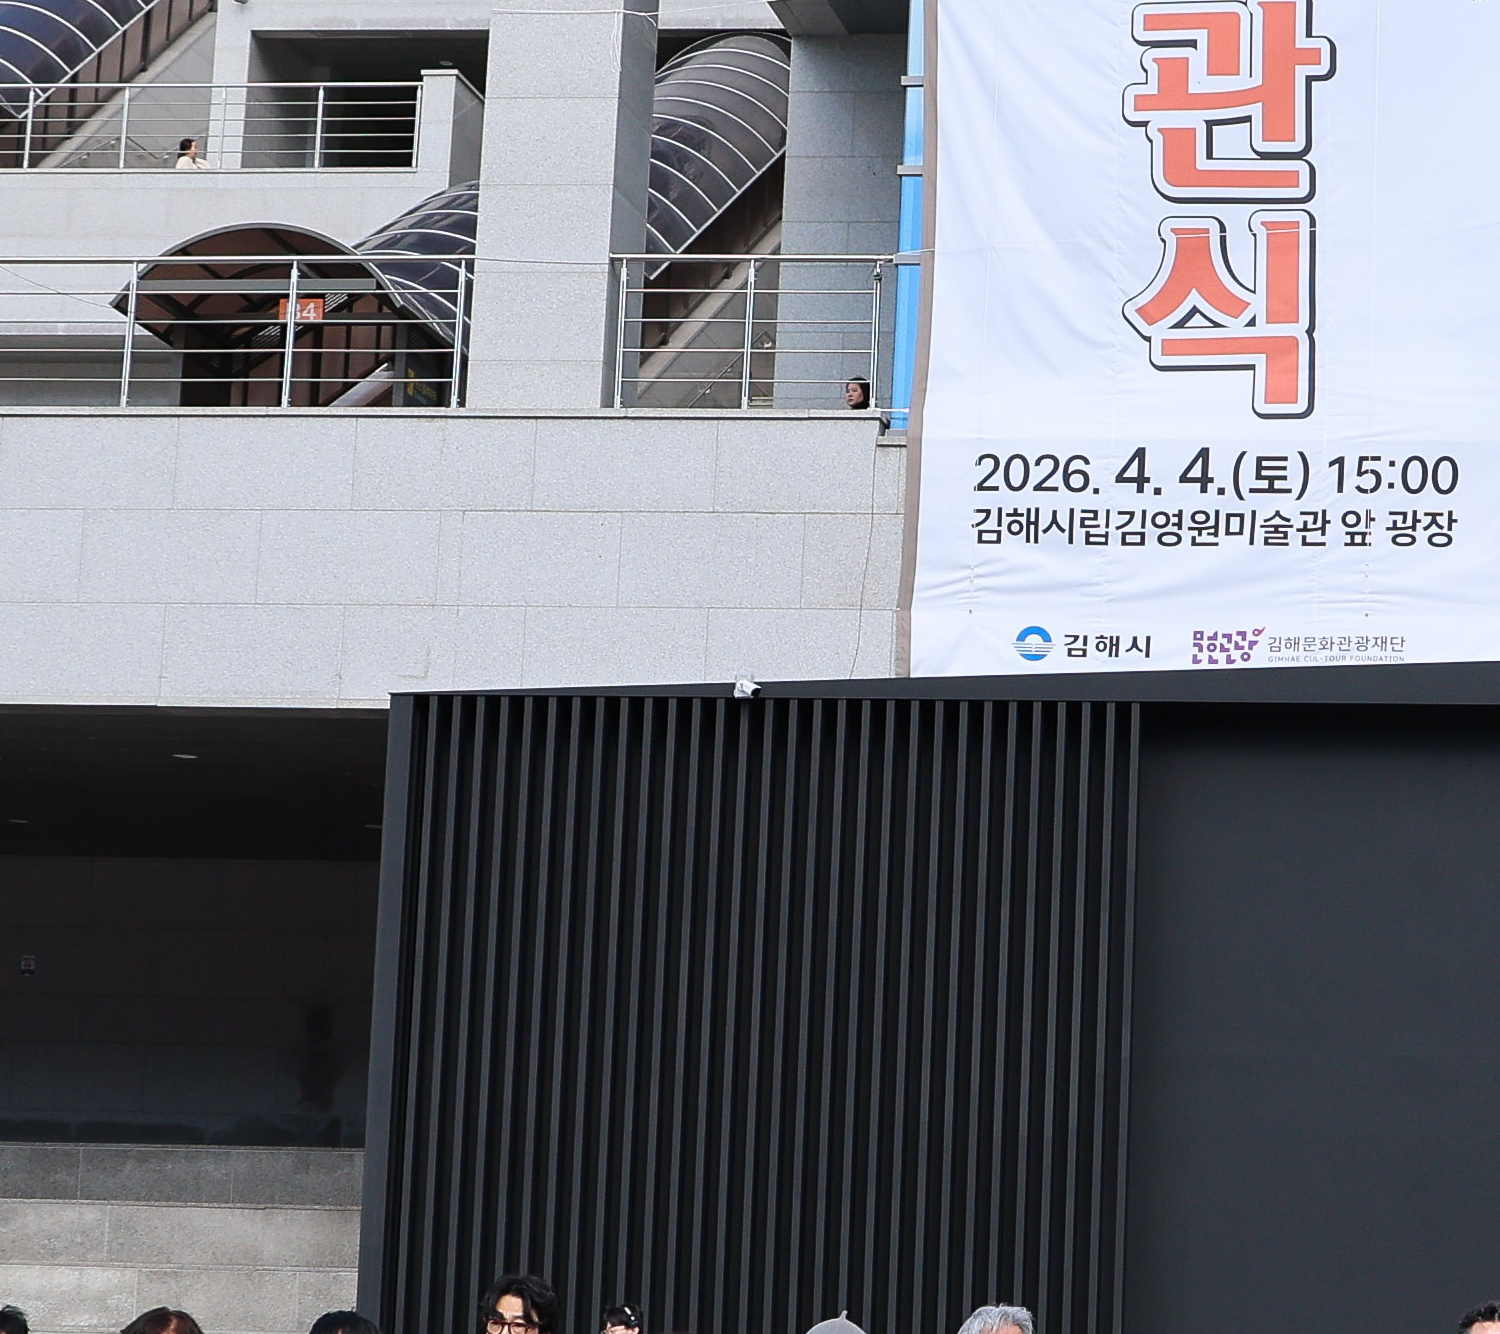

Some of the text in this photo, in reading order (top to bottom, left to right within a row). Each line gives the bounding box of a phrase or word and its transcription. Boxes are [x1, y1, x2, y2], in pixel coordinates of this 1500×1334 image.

[974, 446, 1459, 501] 2026. 4. 4.(토) 15:00
[971, 506, 1458, 549] 김해시립김영원미술관 앞 광장
[1064, 634, 1152, 659] 김해시
[1267, 635, 1406, 653] 김해문화관광재단
[1267, 654, 1406, 663] GIMHAE CUL-TOUR FOUNDATION
